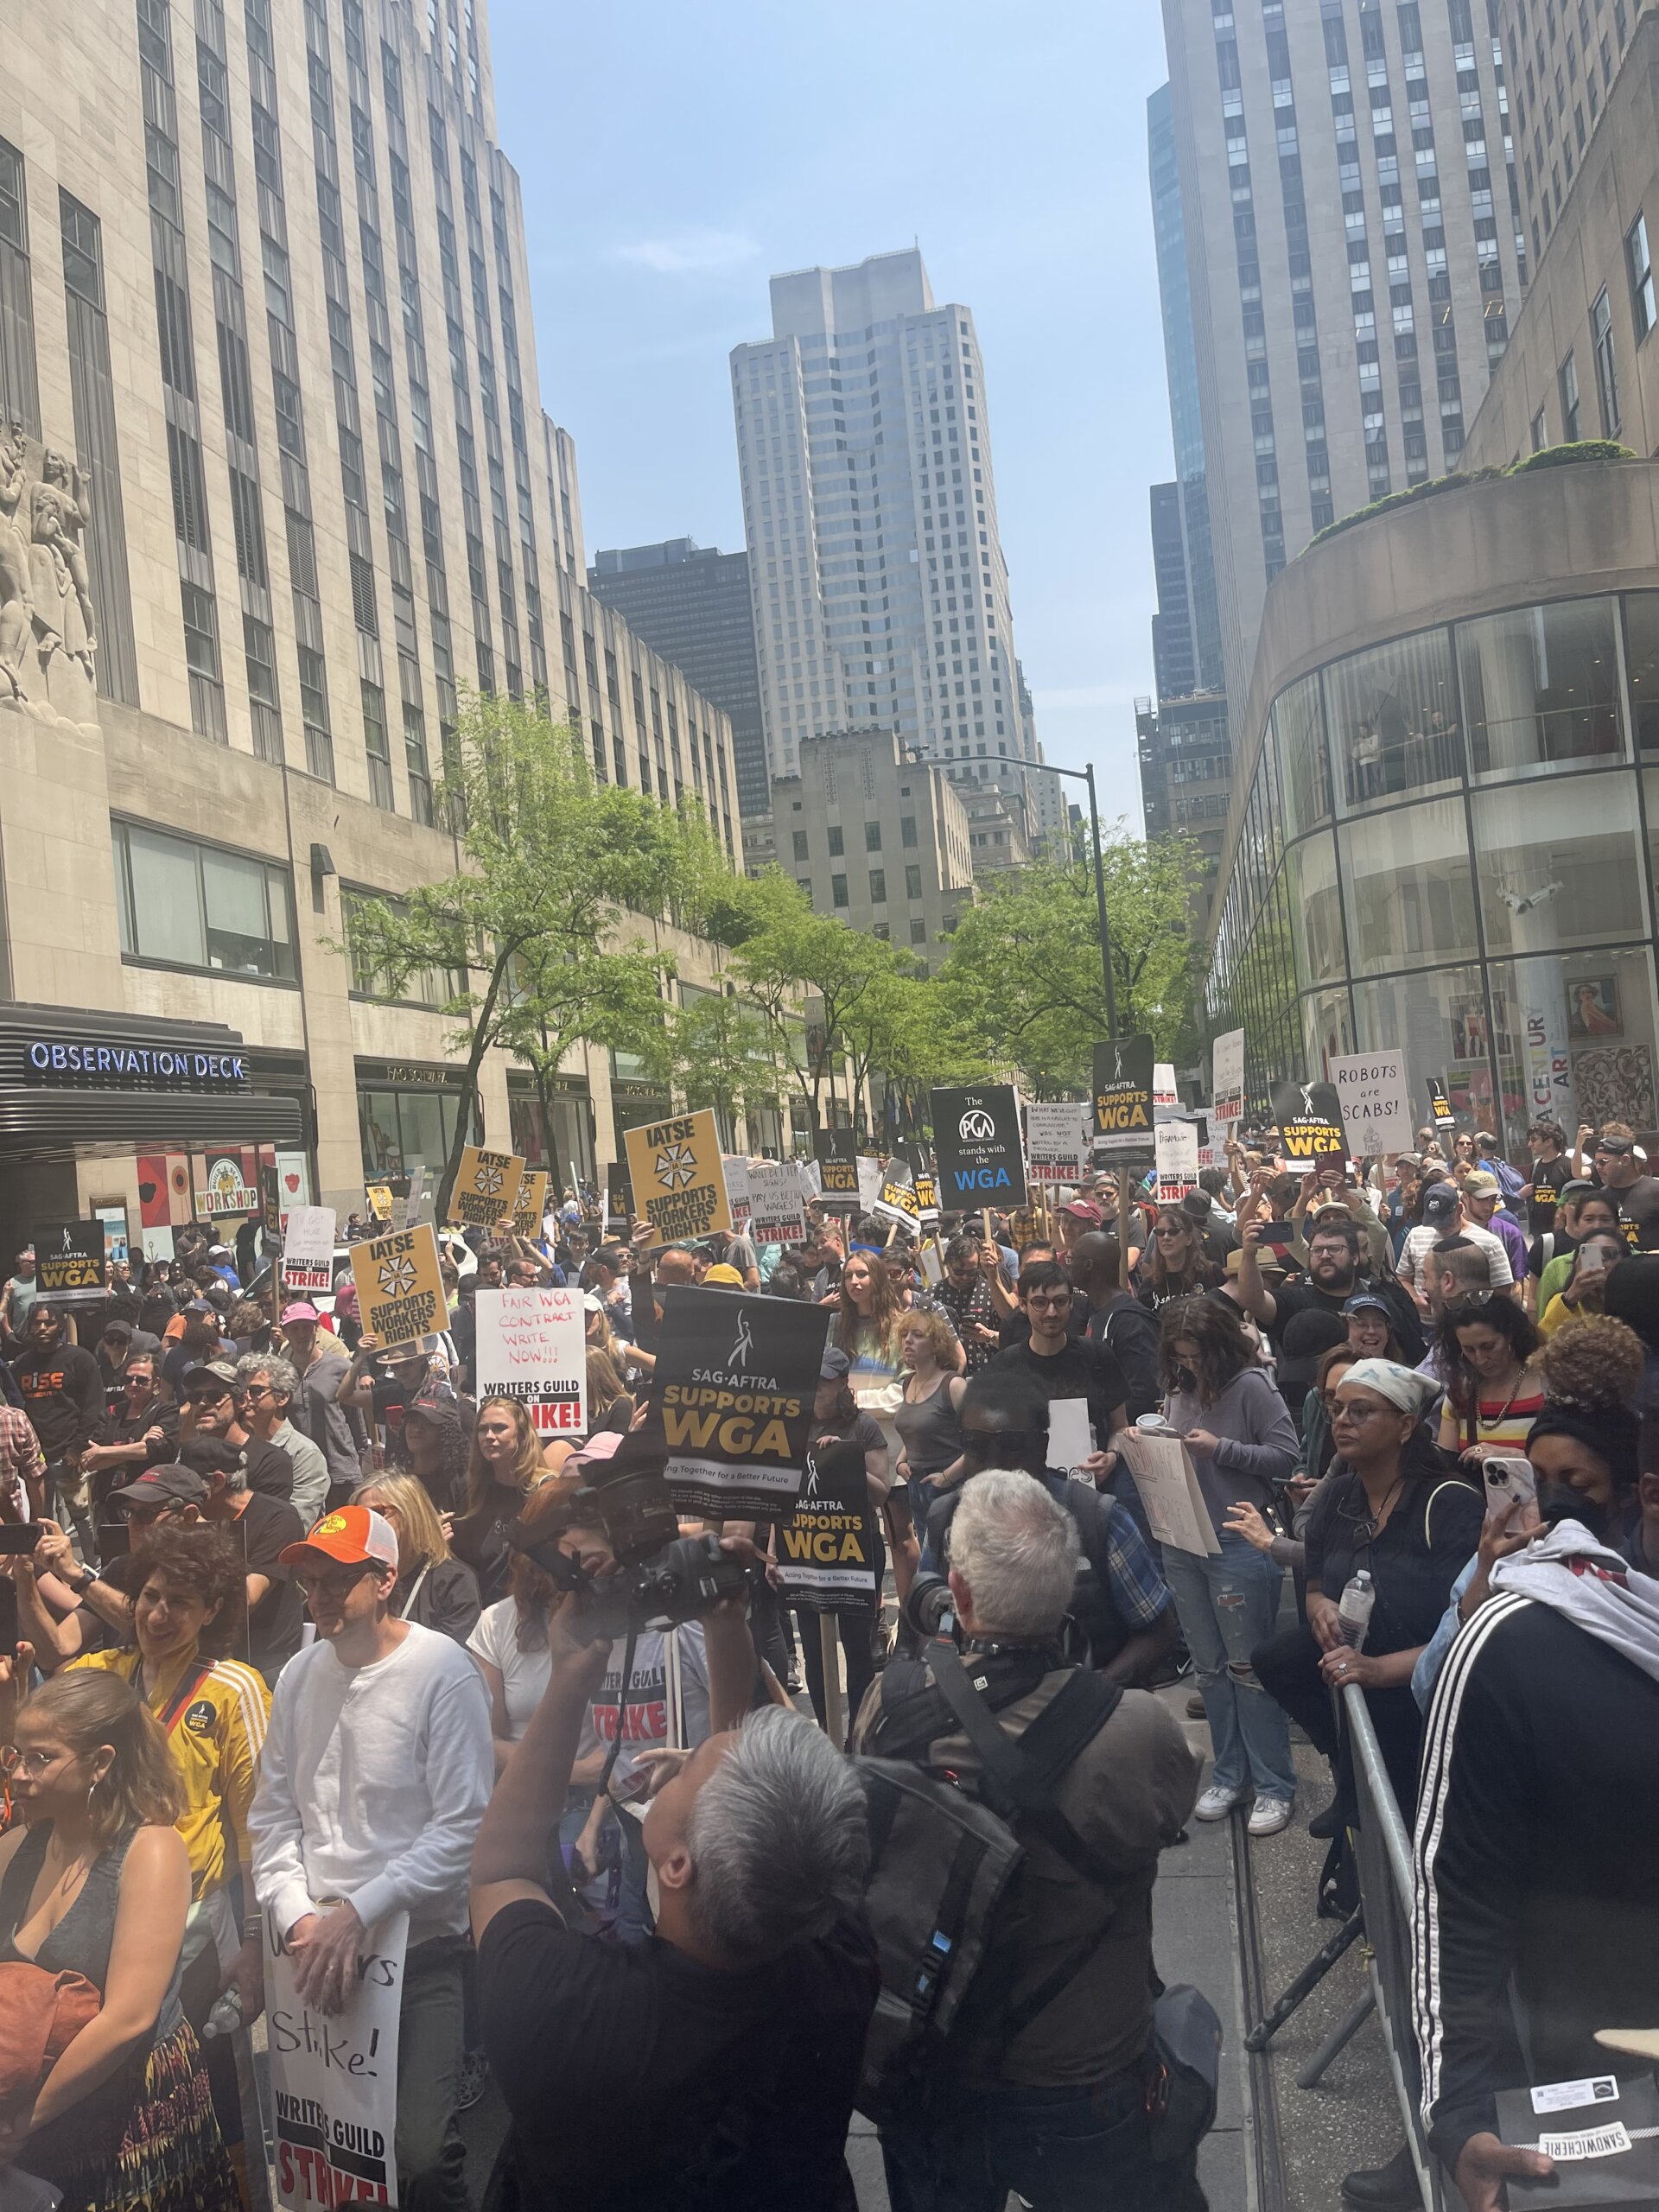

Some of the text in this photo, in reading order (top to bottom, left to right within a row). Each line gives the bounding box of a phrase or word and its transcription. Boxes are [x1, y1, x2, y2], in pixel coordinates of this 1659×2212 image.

[31, 1042, 244, 1079] OBSERVATION DECK
[1526, 1006, 1552, 1105] CENTURY
[1339, 1065, 1397, 1084] ROBOTS
[1551, 1046, 1570, 1088] ART
[965, 1096, 982, 1106] The
[1097, 1091, 1148, 1107] SUPPORTS
[1153, 1095, 1177, 1103] STRIKE!
[1360, 1088, 1380, 1098] are
[1097, 1104, 1148, 1130] WGA
[1215, 1100, 1242, 1121] STRIKE!
[1343, 1100, 1398, 1121] SCABS!
[646, 1118, 695, 1148] IATSE
[959, 1109, 995, 1139] PGA
[1283, 1126, 1341, 1138] SUPPORTS
[958, 1144, 1006, 1156] stands with
[1285, 1136, 1342, 1156] WGA
[477, 1151, 512, 1169] IATSE
[823, 1165, 855, 1173] SUPPORTS
[976, 1155, 989, 1165] the
[748, 1169, 768, 1179] WANT
[823, 1173, 856, 1189] WGA
[954, 1167, 1011, 1191] WGA
[1031, 1166, 1079, 1180] STRIKE!
[195, 1189, 257, 1213] WORKSHOP
[460, 1192, 508, 1210] SUPPORTS
[645, 1184, 717, 1214] SUPPORTS
[752, 1192, 766, 1203] PAY
[769, 1192, 778, 1201] US
[885, 1183, 917, 1203] SUPPOR
[917, 1190, 936, 1206] WG
[1160, 1185, 1198, 1200] STRI
[457, 1200, 506, 1218] WORKERS'
[733, 1205, 752, 1219] IKE!
[884, 1188, 920, 1220] WGA
[462, 1211, 497, 1226] RIGHTS
[647, 1199, 717, 1228] WORKERS'
[754, 1214, 780, 1224] WRITERS
[661, 1216, 711, 1242] RIGHTS
[756, 1224, 804, 1243] STRIKE!
[369, 1232, 415, 1261] IATSE
[41, 1259, 100, 1271] SUPPORTS
[286, 1257, 314, 1266] WRITERS
[41, 1268, 101, 1287] WGA
[285, 1271, 329, 1287] STRIKE!
[369, 1290, 435, 1321] SUPPORTS
[501, 1292, 571, 1308] FAIR WGA
[372, 1303, 436, 1333] WORKERS'
[499, 1312, 577, 1328] CONTRACT
[384, 1319, 430, 1345] RIGHTS
[502, 1332, 550, 1347] WRITE
[509, 1346, 558, 1363] NOW!!!
[484, 1380, 579, 1395] WRITERS GUILD
[527, 1394, 540, 1403] ON
[663, 1385, 801, 1418] SUPPORTS
[532, 1402, 582, 1430] IKE!
[662, 1407, 791, 1459] WGA
[680, 1465, 716, 1478] Together
[717, 1470, 728, 1478] for
[736, 1472, 760, 1482] Better
[762, 1472, 789, 1484] Future
[792, 1513, 862, 1530] UPPORTS
[783, 1529, 866, 1563] WGA
[189, 1719, 206, 1729] WGA
[272, 2009, 380, 2077] Strike!
[334, 2119, 385, 2159] GUILD
[1544, 2132, 1625, 2156] SANDWICHERIE
